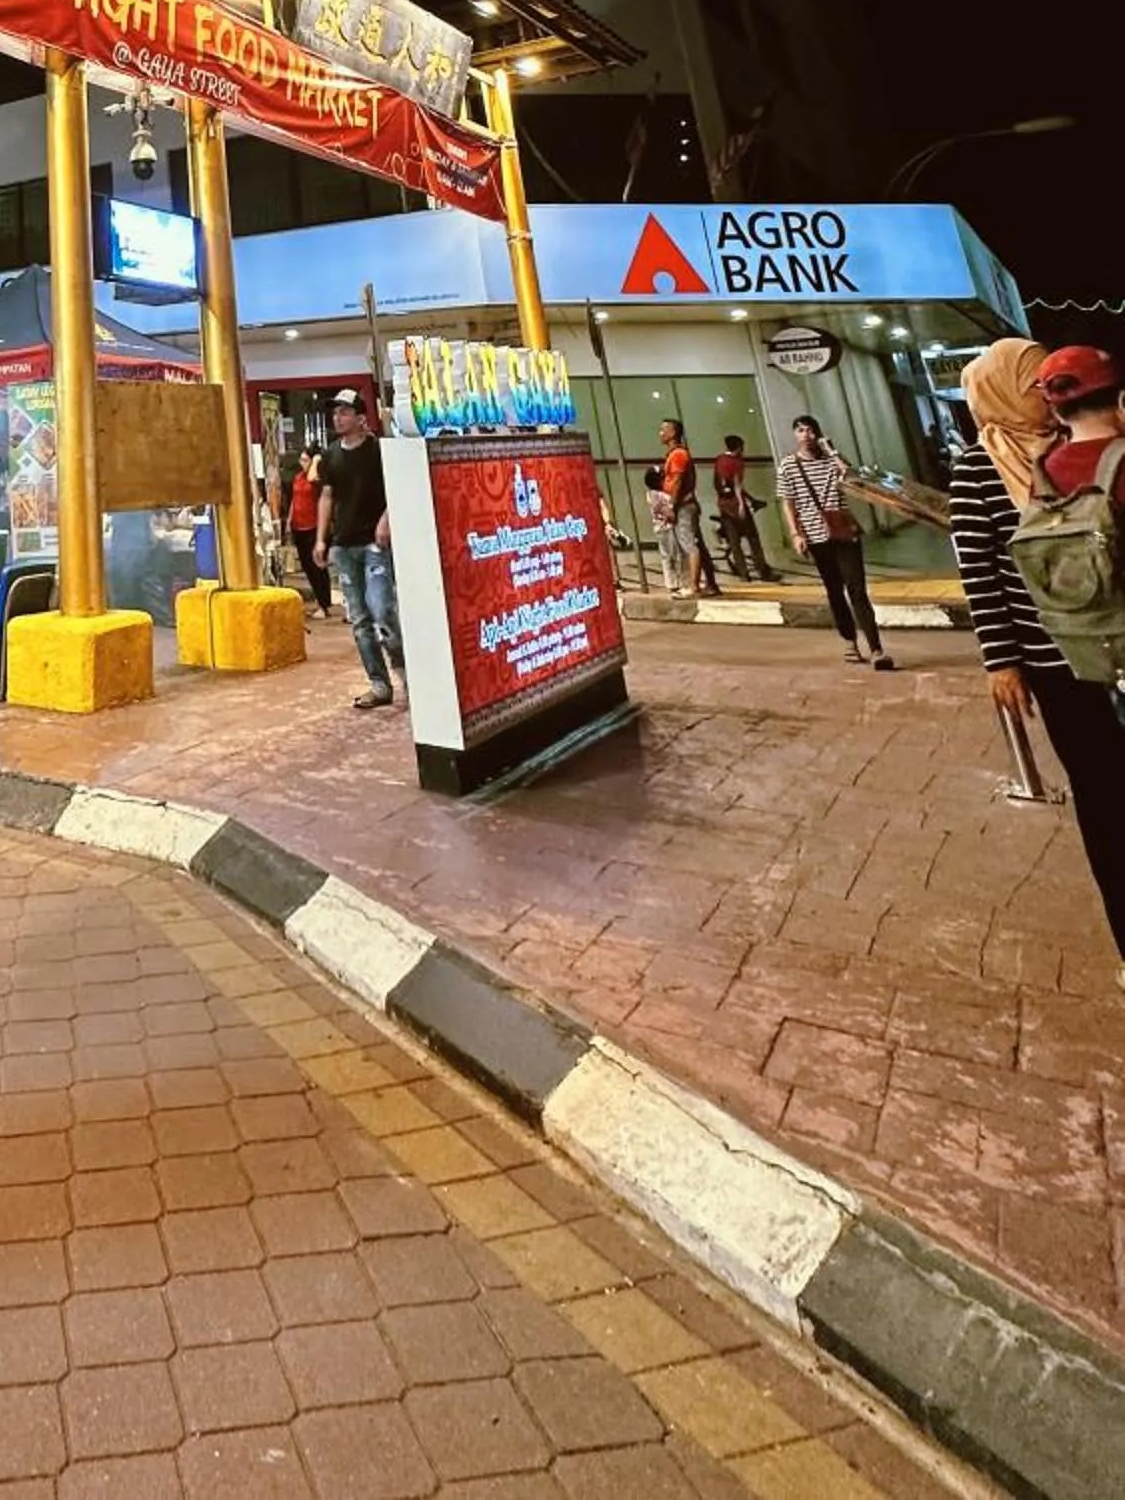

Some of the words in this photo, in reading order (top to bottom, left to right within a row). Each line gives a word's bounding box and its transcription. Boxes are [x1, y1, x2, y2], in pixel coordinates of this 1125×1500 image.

[112, 41, 134, 68] @
[137, 46, 186, 88] GAYA
[190, 67, 242, 107] STREET
[194, 5, 279, 88] FOOD
[286, 49, 383, 140] MARKET
[717, 211, 846, 249] AGRO
[720, 254, 859, 293] BANK
